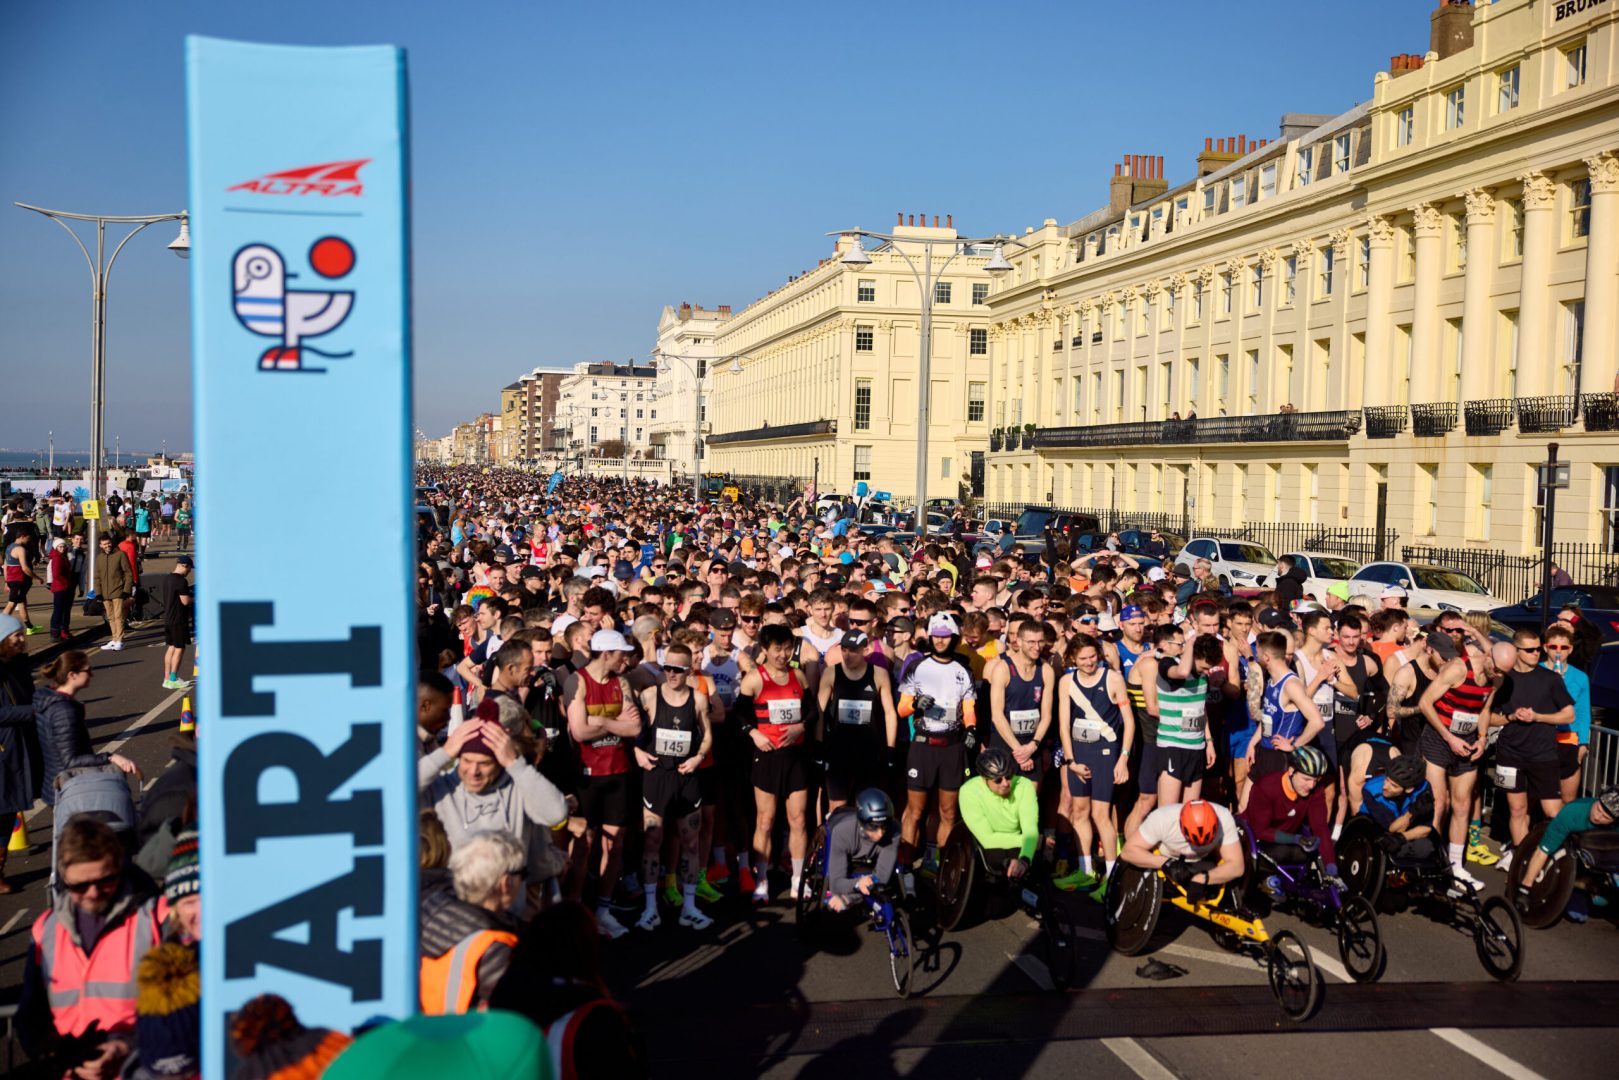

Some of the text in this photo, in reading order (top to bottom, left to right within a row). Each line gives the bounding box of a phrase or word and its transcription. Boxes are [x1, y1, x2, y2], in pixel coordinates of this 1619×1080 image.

[1555, 0, 1606, 21] BRUN
[225, 179, 365, 197] ALTRA
[780, 709, 793, 720] 35
[1018, 719, 1035, 731] 172
[1457, 721, 1472, 731] 102
[1081, 729, 1087, 740] 4
[664, 741, 684, 753] 145
[219, 601, 385, 1080] ART
